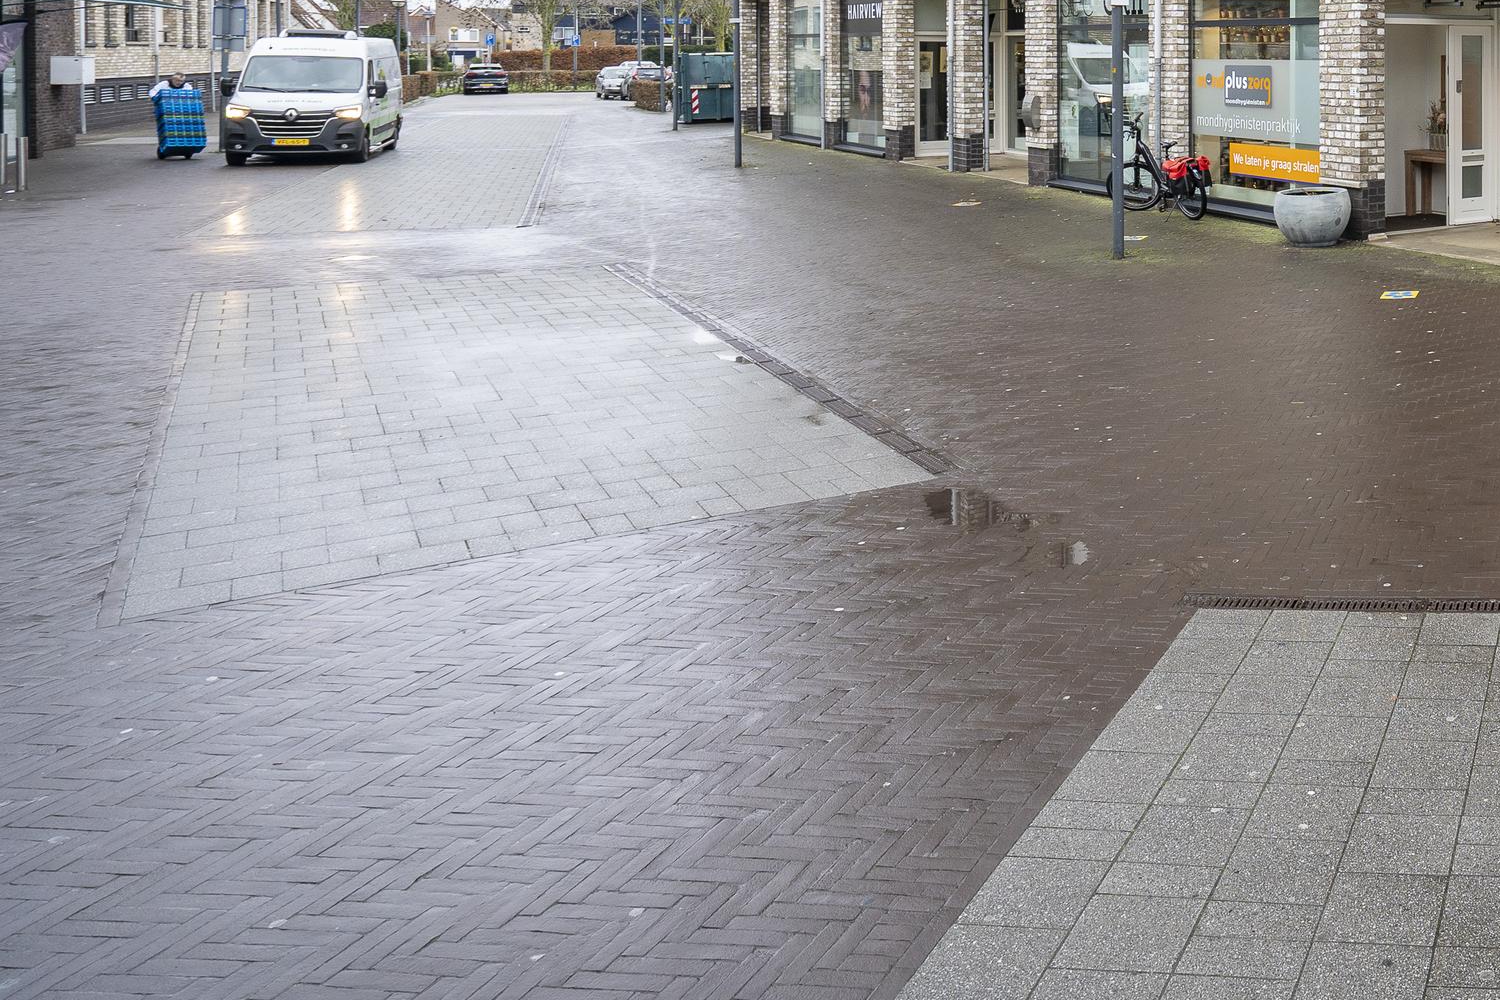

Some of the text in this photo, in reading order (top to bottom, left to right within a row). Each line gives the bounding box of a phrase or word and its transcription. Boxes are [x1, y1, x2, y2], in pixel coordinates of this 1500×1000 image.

[847, 2, 883, 20] HAIRVIEW
[1196, 113, 1301, 138] mondhygiënistenpraktijk
[1233, 153, 1319, 174] We laten je graag stralen
